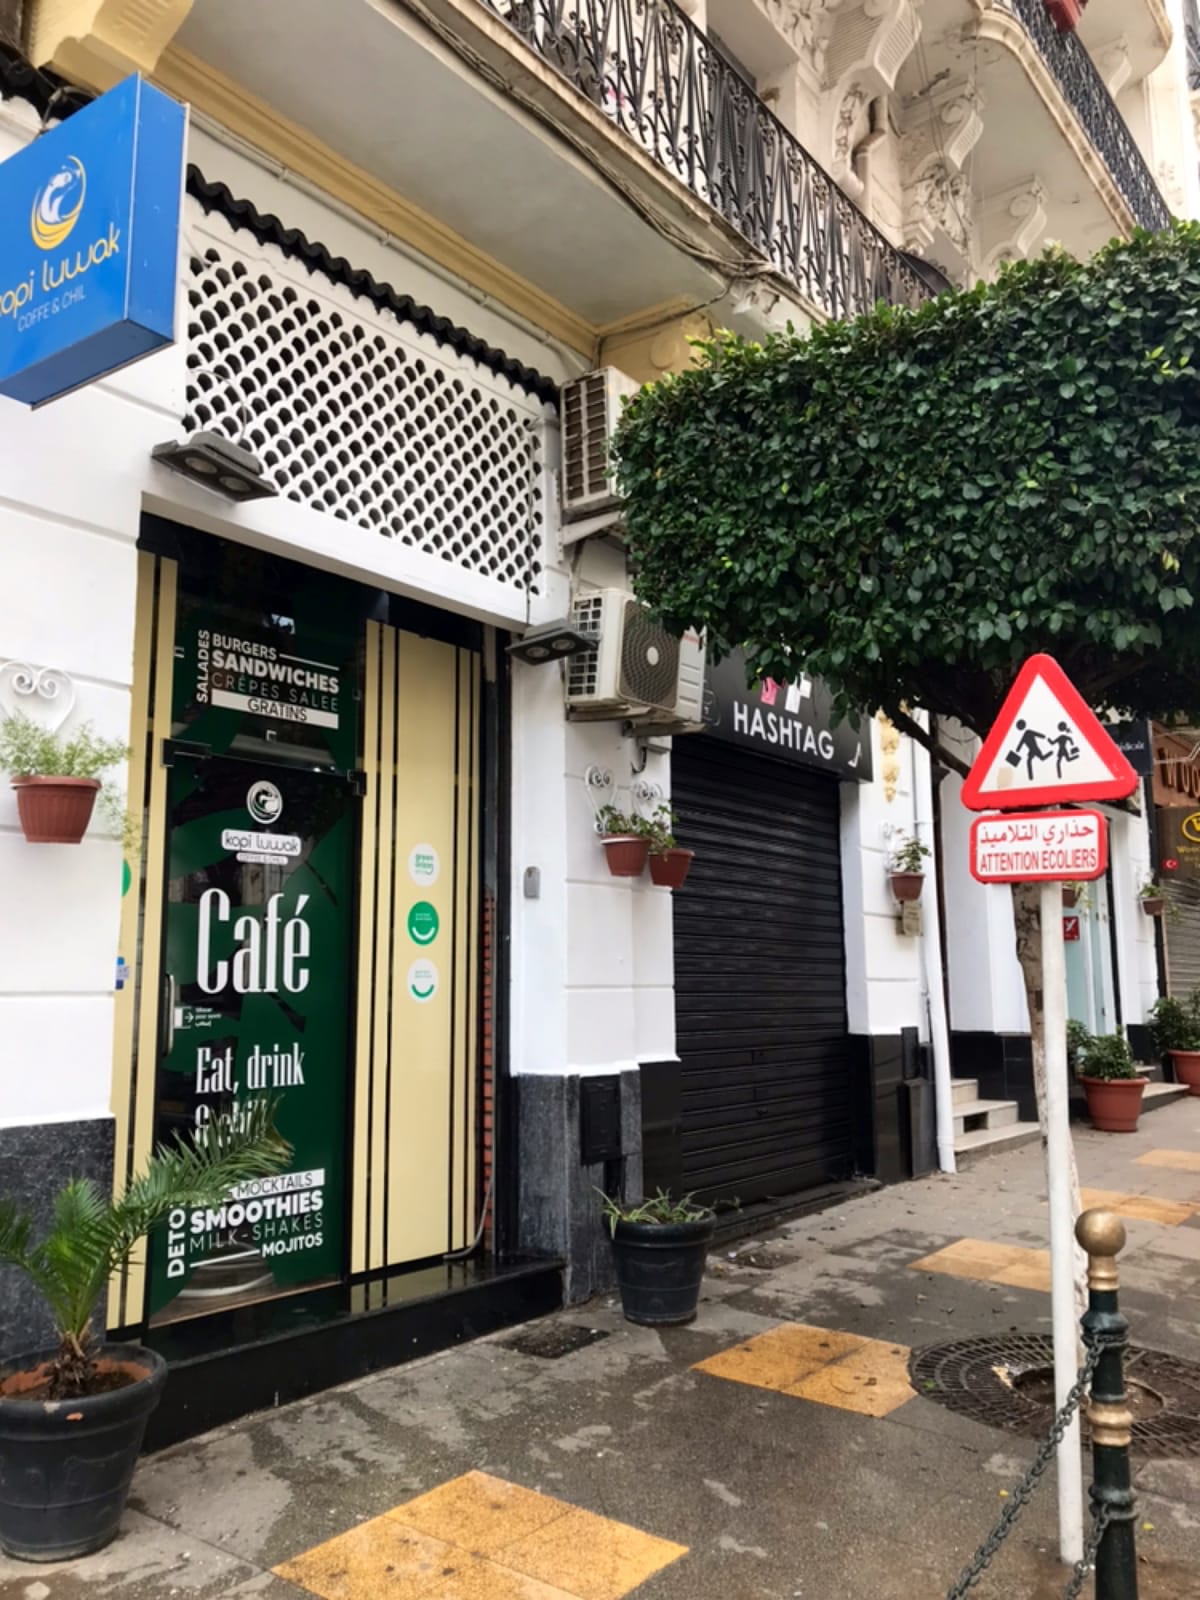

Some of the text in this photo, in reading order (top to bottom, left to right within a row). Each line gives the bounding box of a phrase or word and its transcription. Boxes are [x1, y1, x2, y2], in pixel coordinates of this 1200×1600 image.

[0, 221, 120, 319] opi luwak
[17, 302, 50, 332] COFFE
[52, 297, 60, 314] &
[197, 630, 209, 703] SALADES
[212, 633, 277, 661] BURGERS
[211, 650, 339, 694] SANDWICHES
[248, 697, 308, 722] GRATINS
[733, 700, 835, 760] HASHTAG
[225, 832, 298, 853] kopi luwak
[980, 819, 1095, 848] حذاري التلاميذ
[980, 848, 1097, 872] ATTENTION ECOLIERS
[197, 888, 310, 994] Café
[195, 1042, 305, 1095] Eat, drink
[238, 1172, 313, 1197] MOCKTAILS
[190, 1190, 323, 1234] SMOOTHIES
[167, 1203, 186, 1278] DETO
[262, 1232, 323, 1259] MOJITOS
